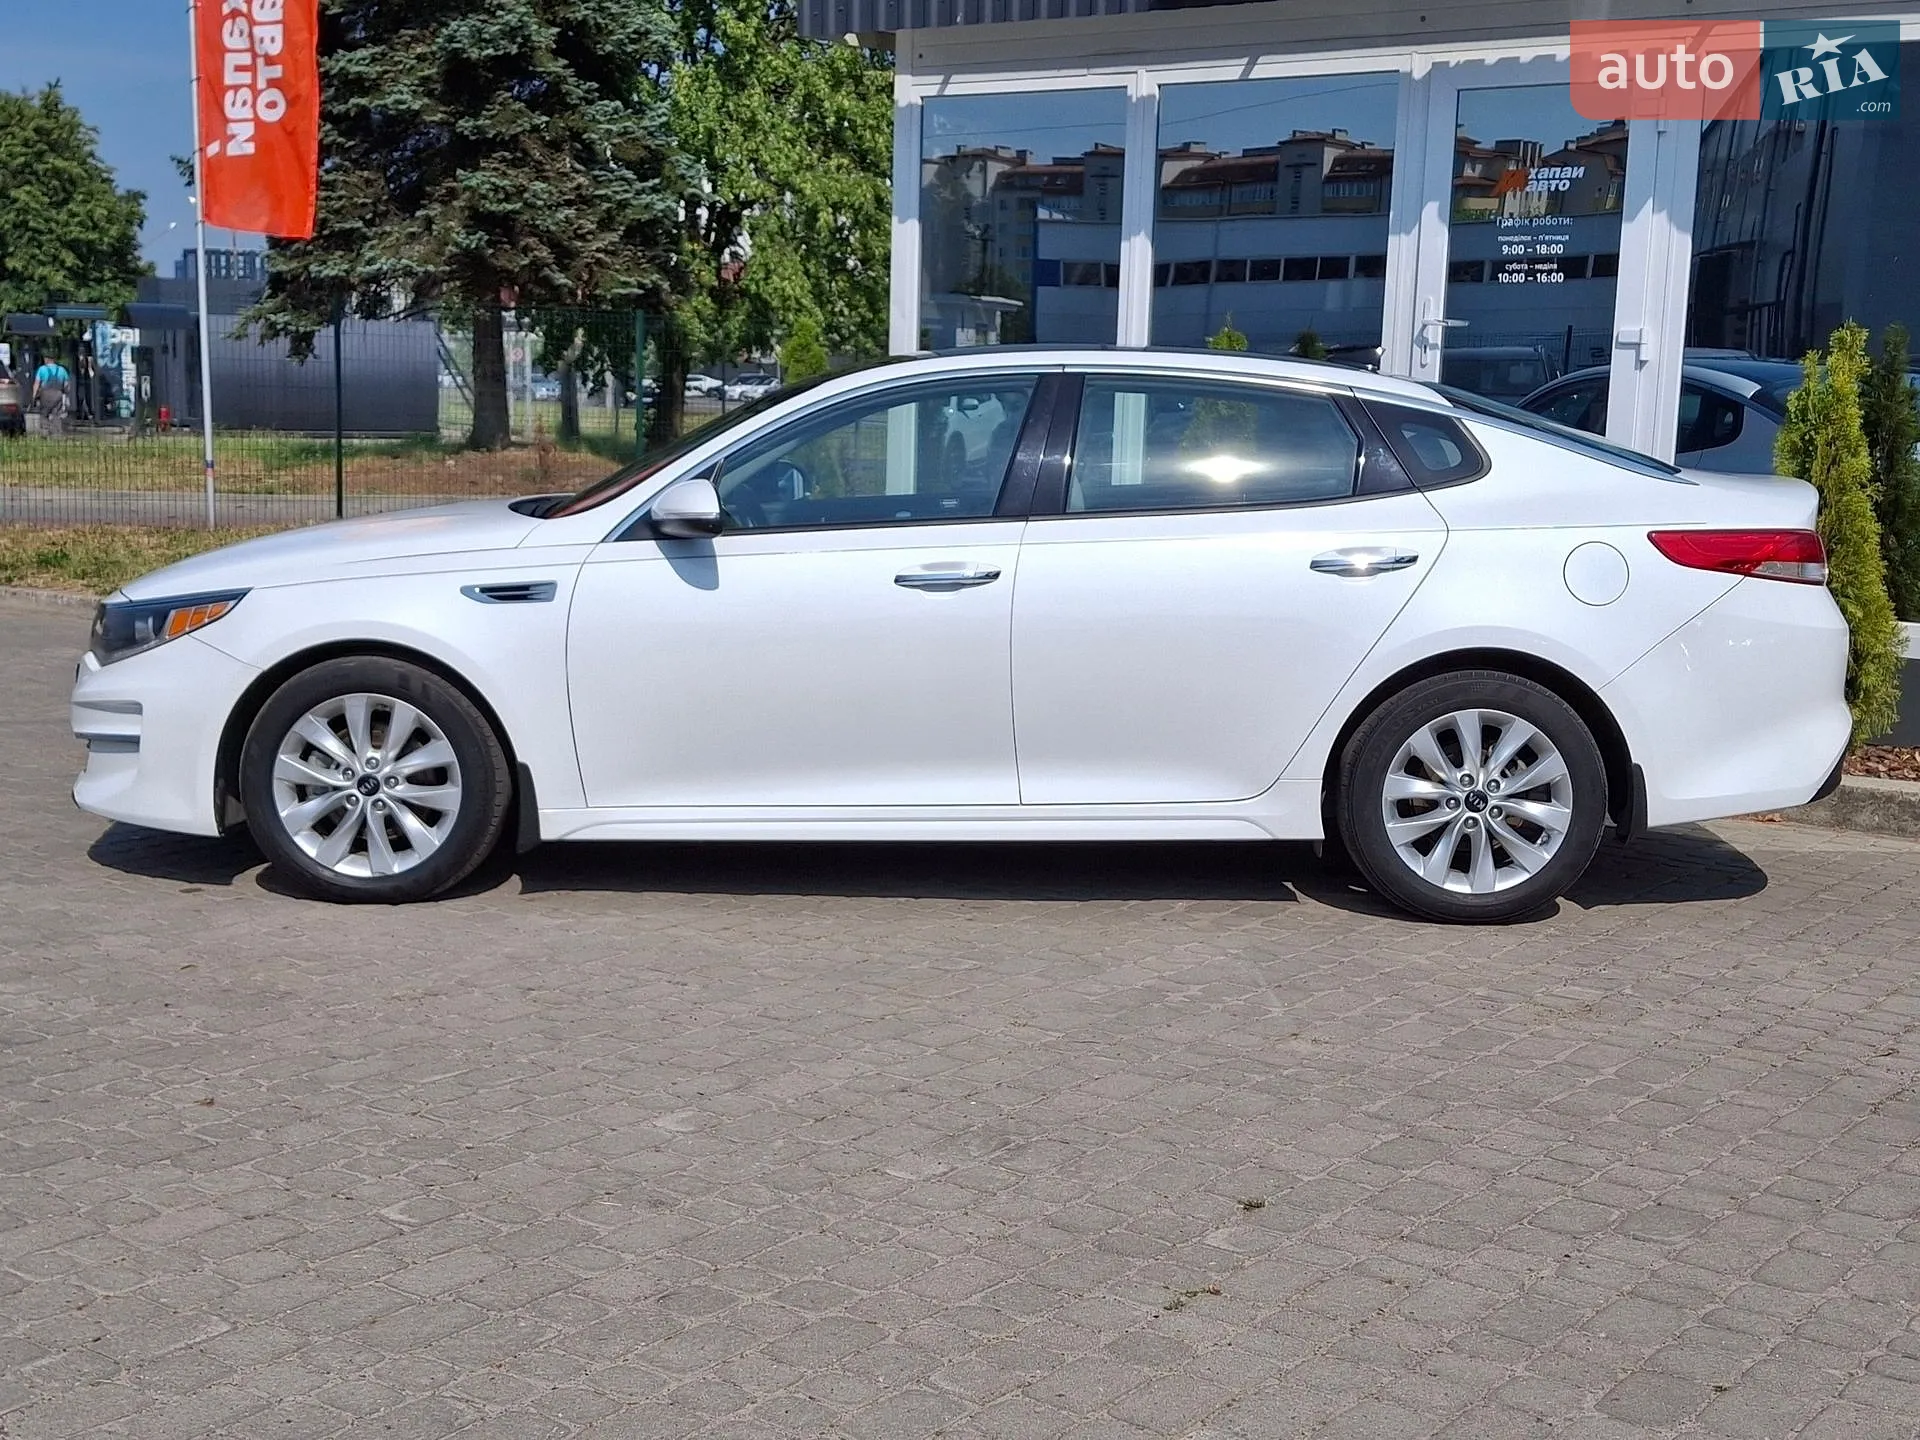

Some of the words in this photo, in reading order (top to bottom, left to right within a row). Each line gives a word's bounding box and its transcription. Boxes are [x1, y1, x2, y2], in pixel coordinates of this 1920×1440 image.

[1524, 179, 1570, 192] авто
[1496, 216, 1530, 229] Графік
[1532, 215, 1573, 227] роботи:
[1502, 244, 1525, 255] 9:00
[1535, 243, 1564, 255] 18:00
[1497, 272, 1525, 283] 10:00
[1536, 272, 1564, 283] 16:00
